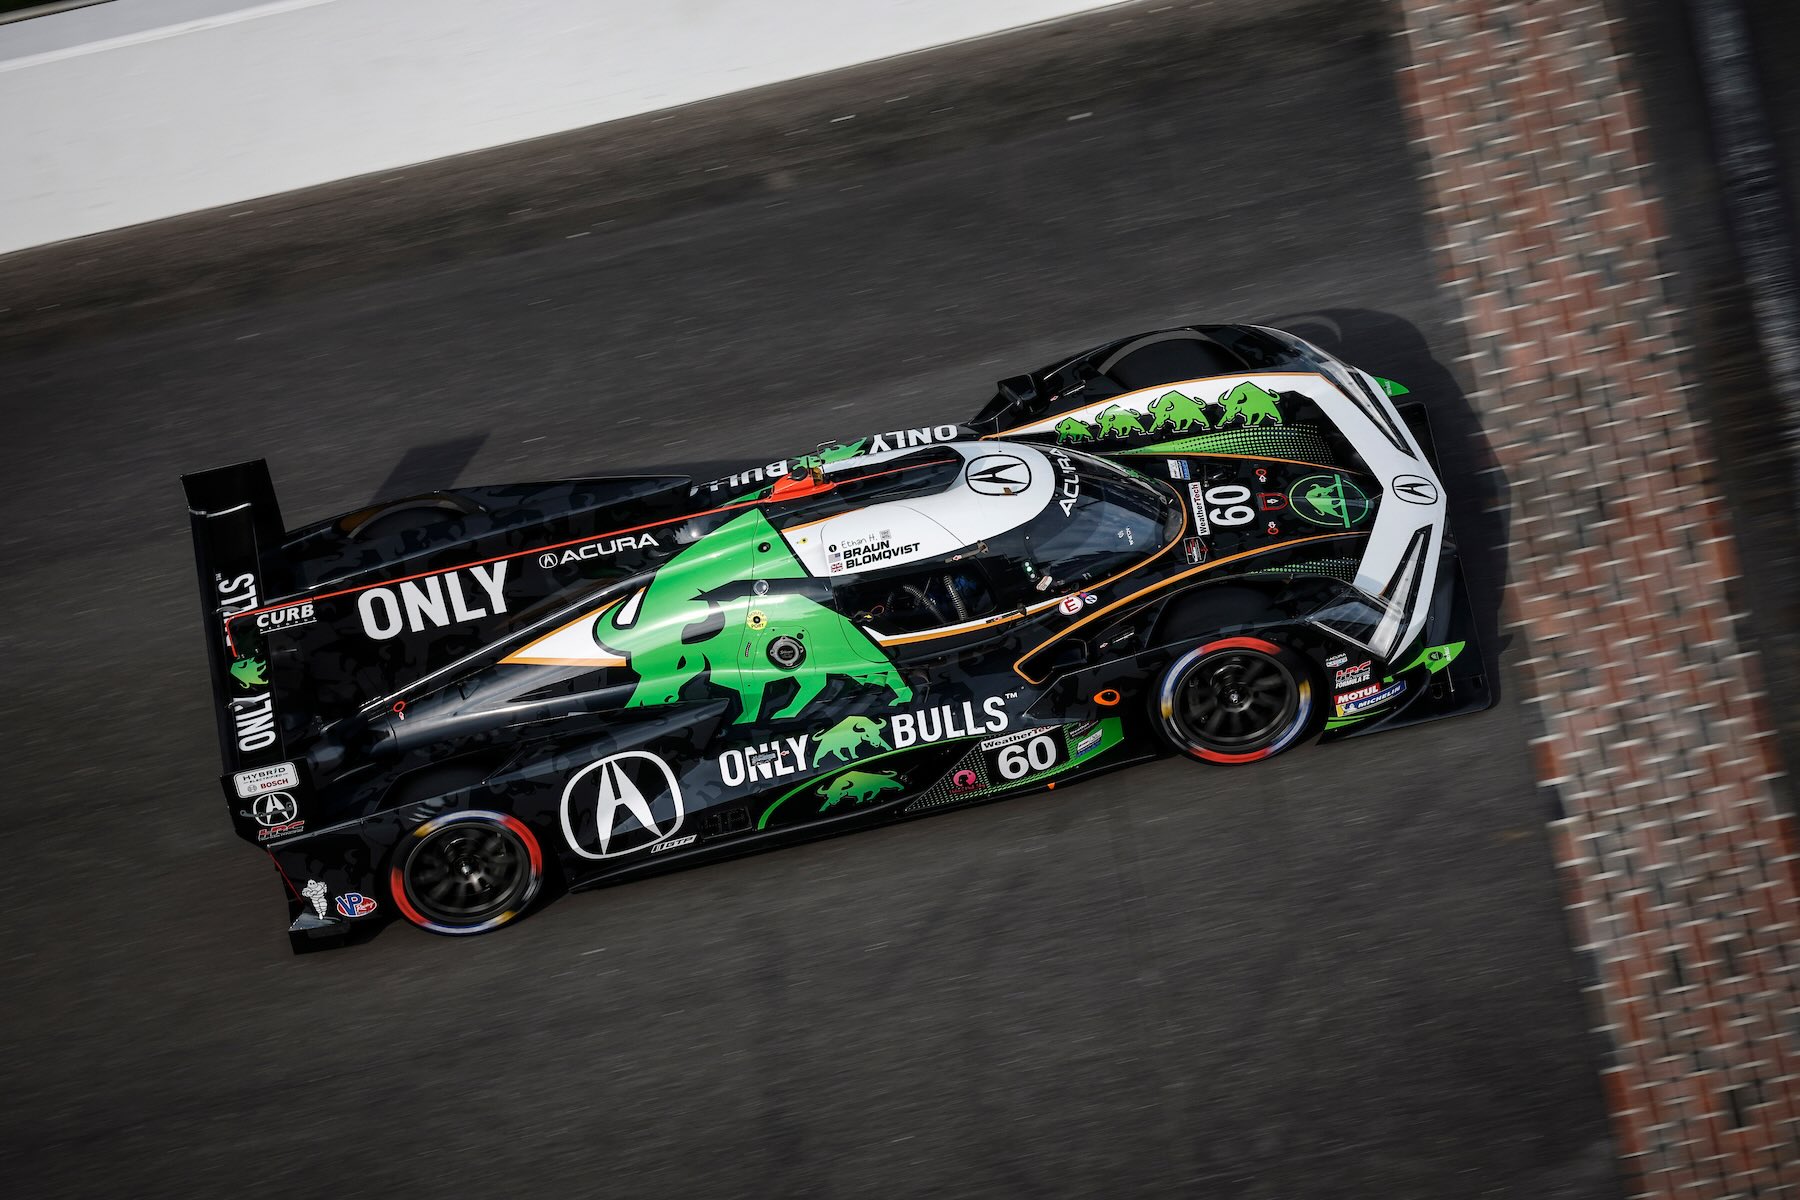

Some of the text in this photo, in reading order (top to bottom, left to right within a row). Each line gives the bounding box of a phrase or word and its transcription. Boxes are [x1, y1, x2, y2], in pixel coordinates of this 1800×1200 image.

[869, 424, 959, 455] ONLY
[1050, 448, 1080, 518] ACURA
[1191, 484, 1207, 534] WeatherTech
[1205, 485, 1255, 526] 60
[560, 533, 659, 565] ACURA
[841, 538, 867, 549] Ethan
[843, 540, 890, 559] BRAUN
[846, 542, 920, 569] BLOMQVIST
[357, 560, 508, 640] ONLY
[256, 604, 315, 628] CURB
[1337, 685, 1379, 704] MOTUL
[1358, 685, 1401, 708] MICHELIN
[233, 692, 276, 751] ONLY
[718, 734, 809, 787] ONLY
[998, 736, 1057, 780] 60
[260, 778, 289, 789] BOSCH
[336, 893, 363, 917] VP
